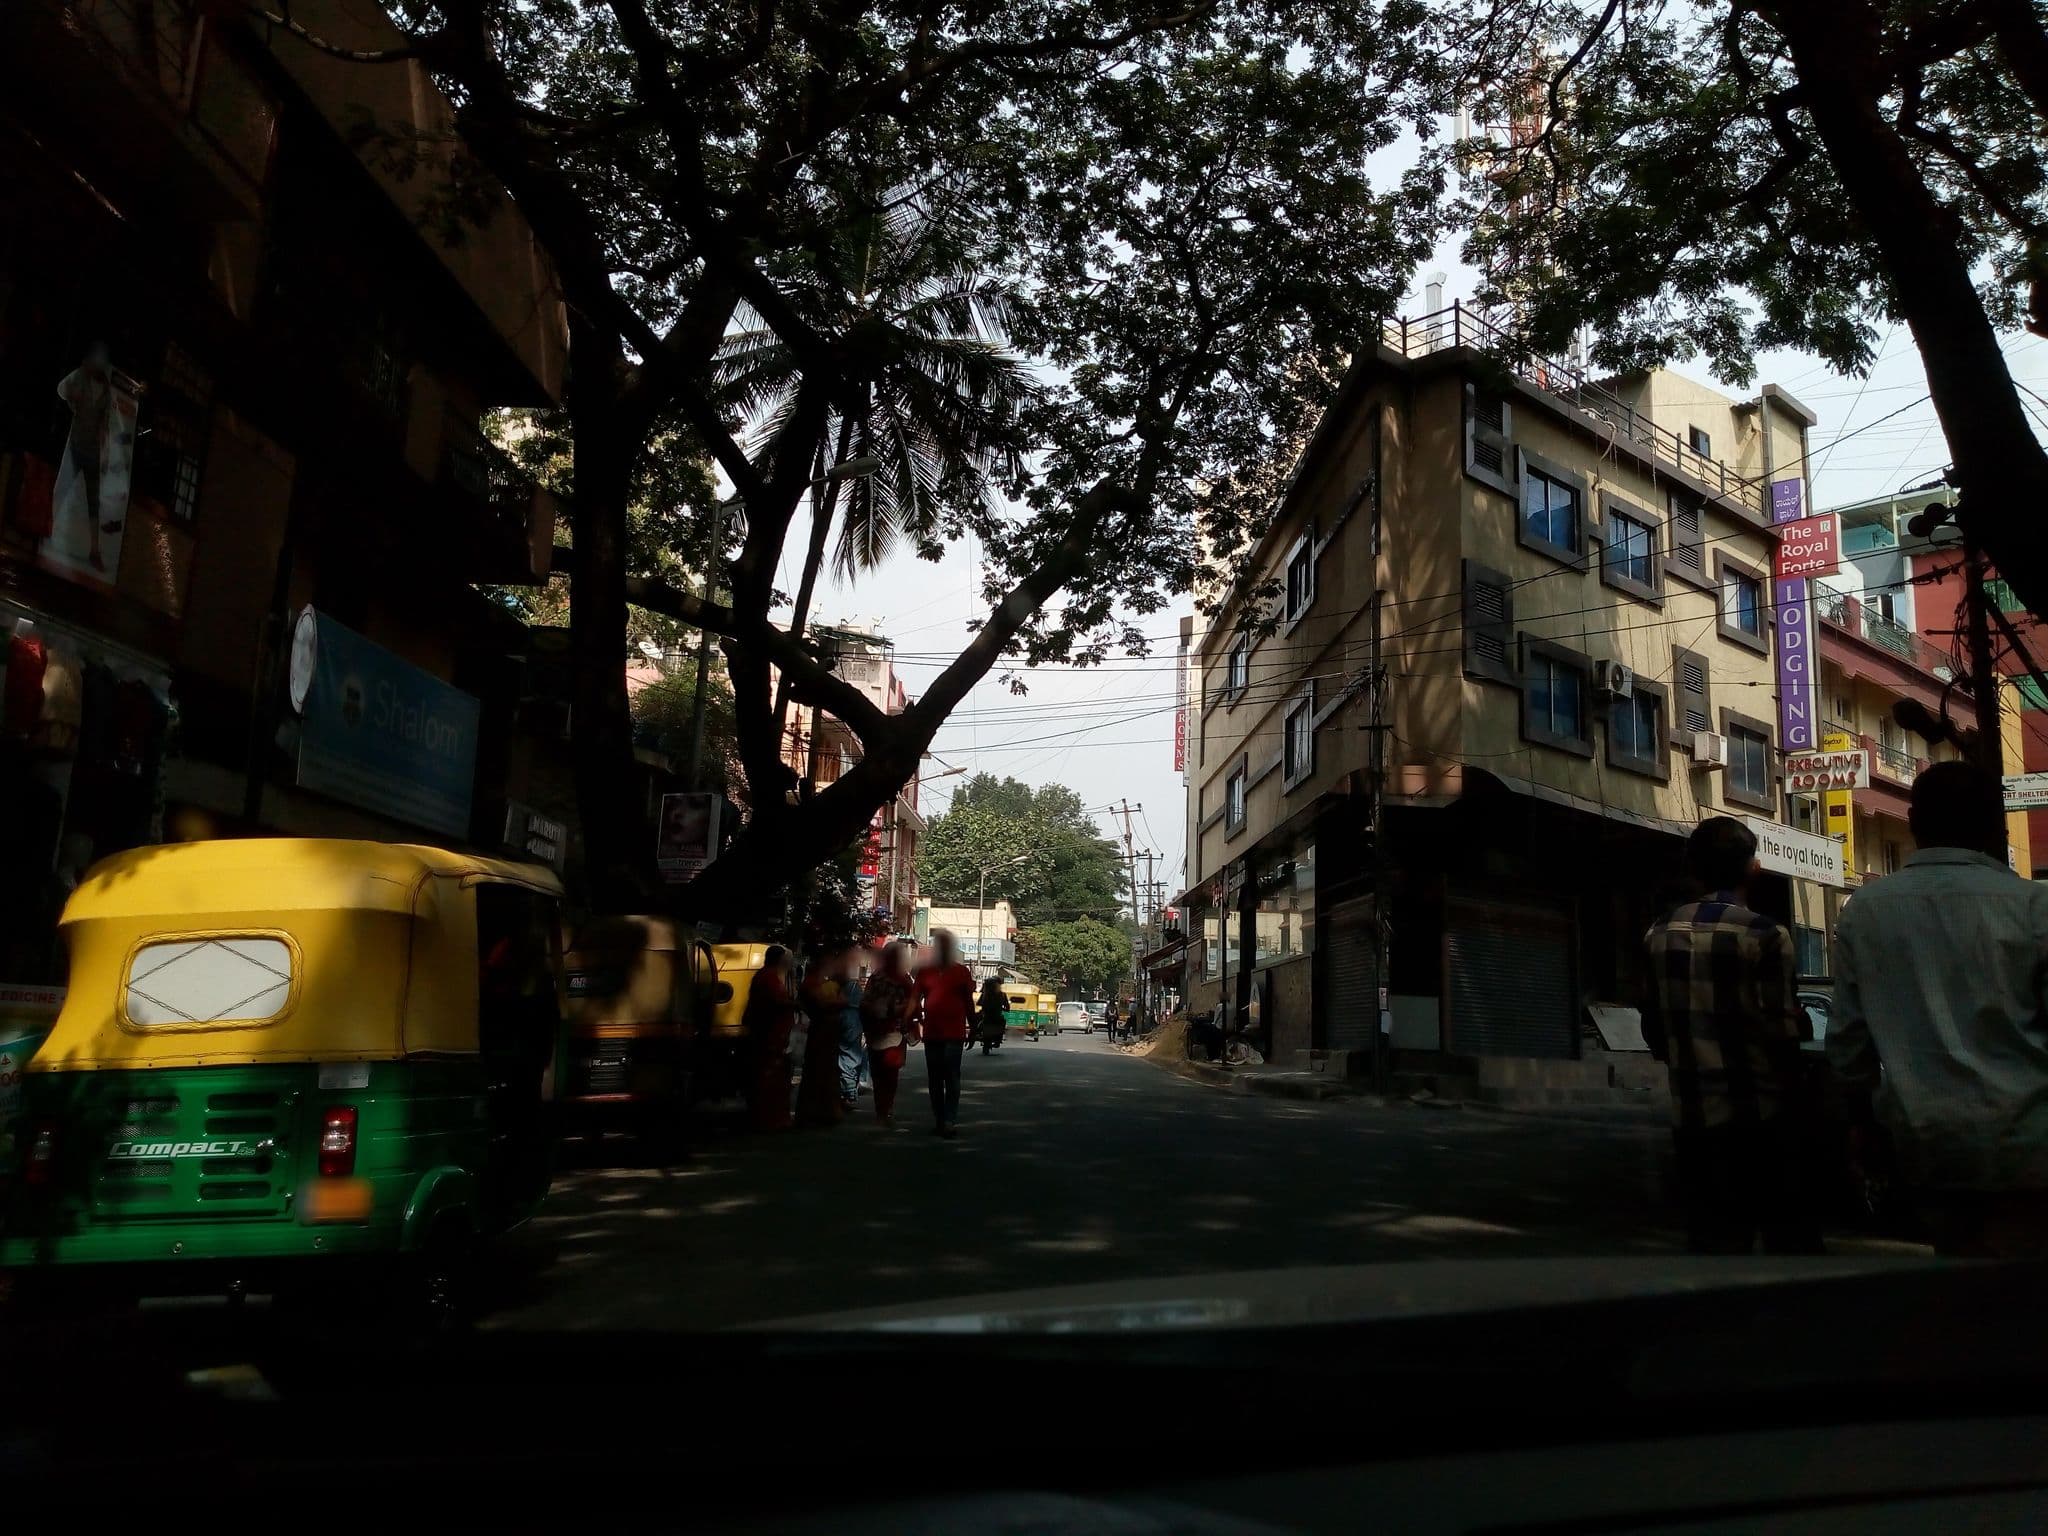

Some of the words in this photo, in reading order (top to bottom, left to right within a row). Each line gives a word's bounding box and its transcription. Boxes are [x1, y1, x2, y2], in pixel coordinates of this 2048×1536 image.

[1782, 526, 1812, 542] The
[1781, 537, 1829, 558] Royal
[1781, 558, 1826, 577] Forte
[1783, 585, 1807, 744] LODGING
[374, 679, 458, 760] Shalom
[1787, 753, 1862, 773] EXECUTIVE
[1793, 771, 1856, 789] ROOMS
[1763, 835, 1780, 857] the
[1782, 844, 1808, 865] royal
[1810, 849, 1834, 870] forte
